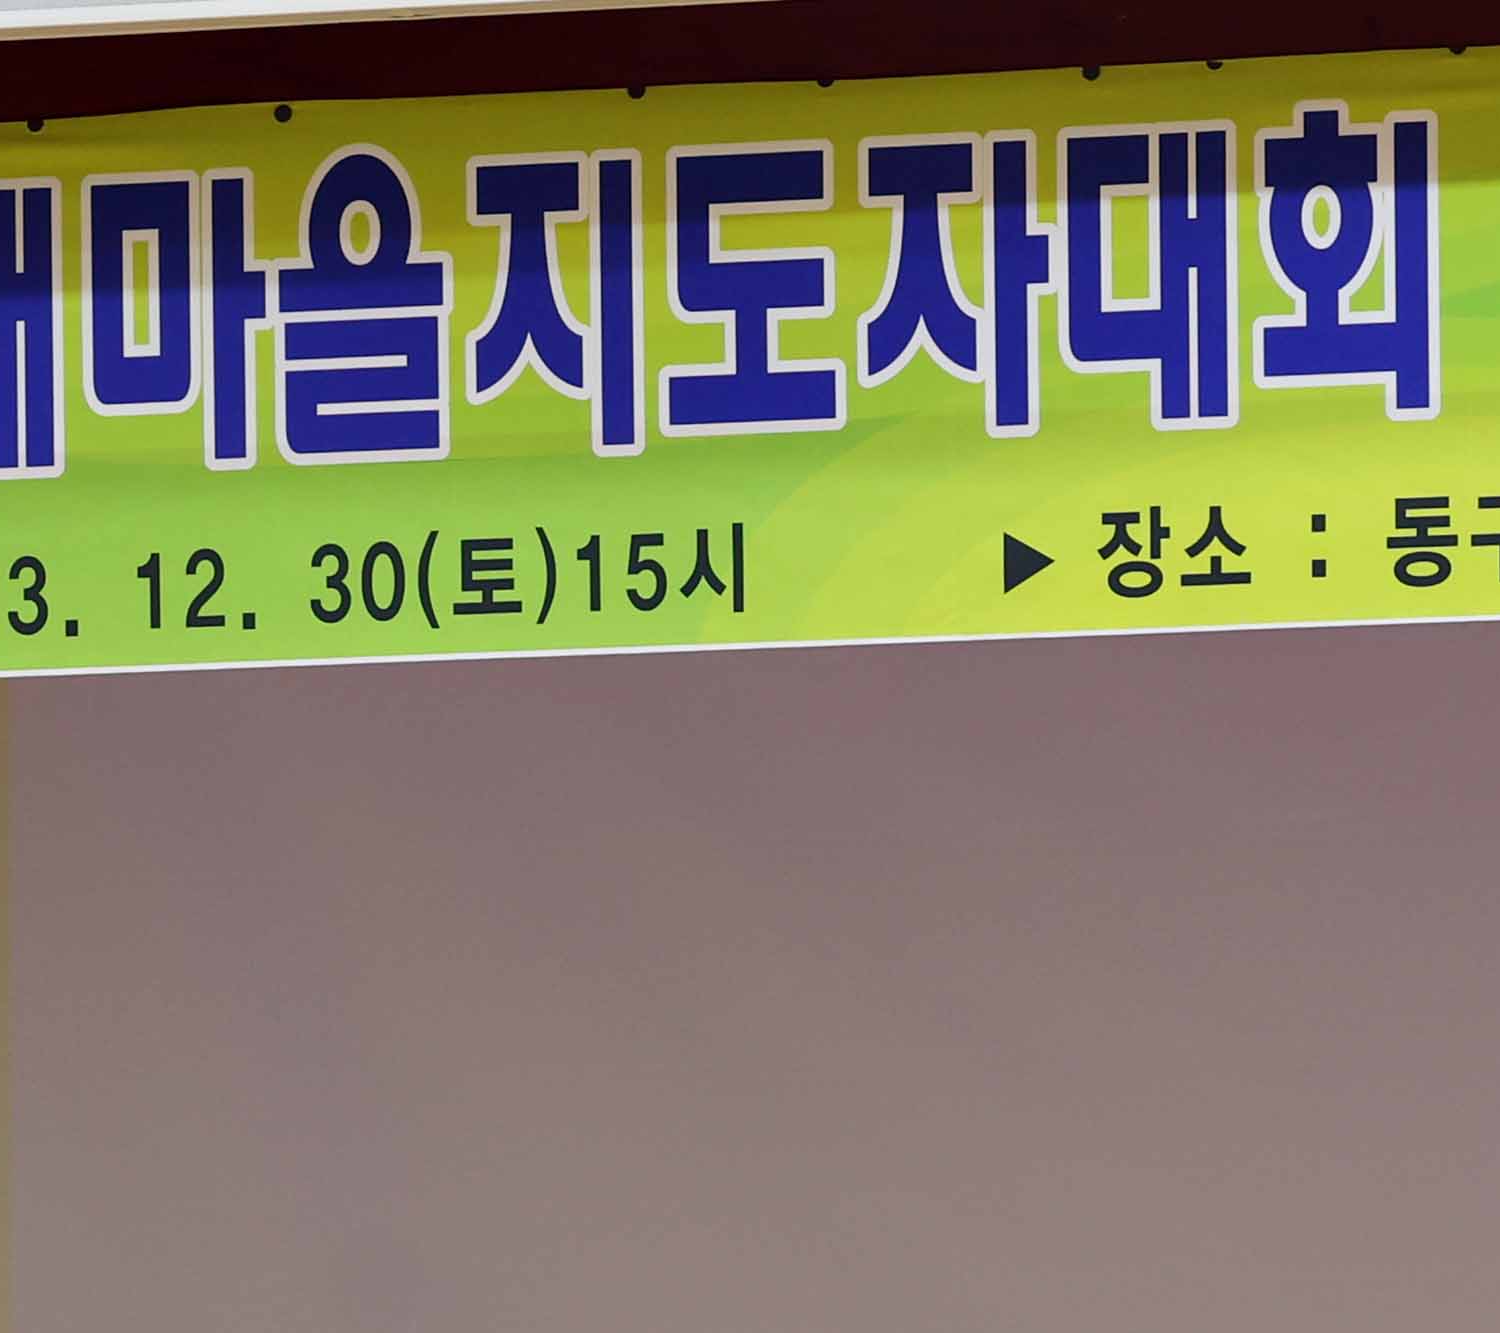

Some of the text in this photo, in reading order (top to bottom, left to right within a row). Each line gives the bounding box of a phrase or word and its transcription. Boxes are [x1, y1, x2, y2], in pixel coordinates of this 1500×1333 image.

[135, 549, 258, 632] 12.
[308, 522, 748, 630] 30(토)15시
[1096, 505, 1248, 598] 장소
